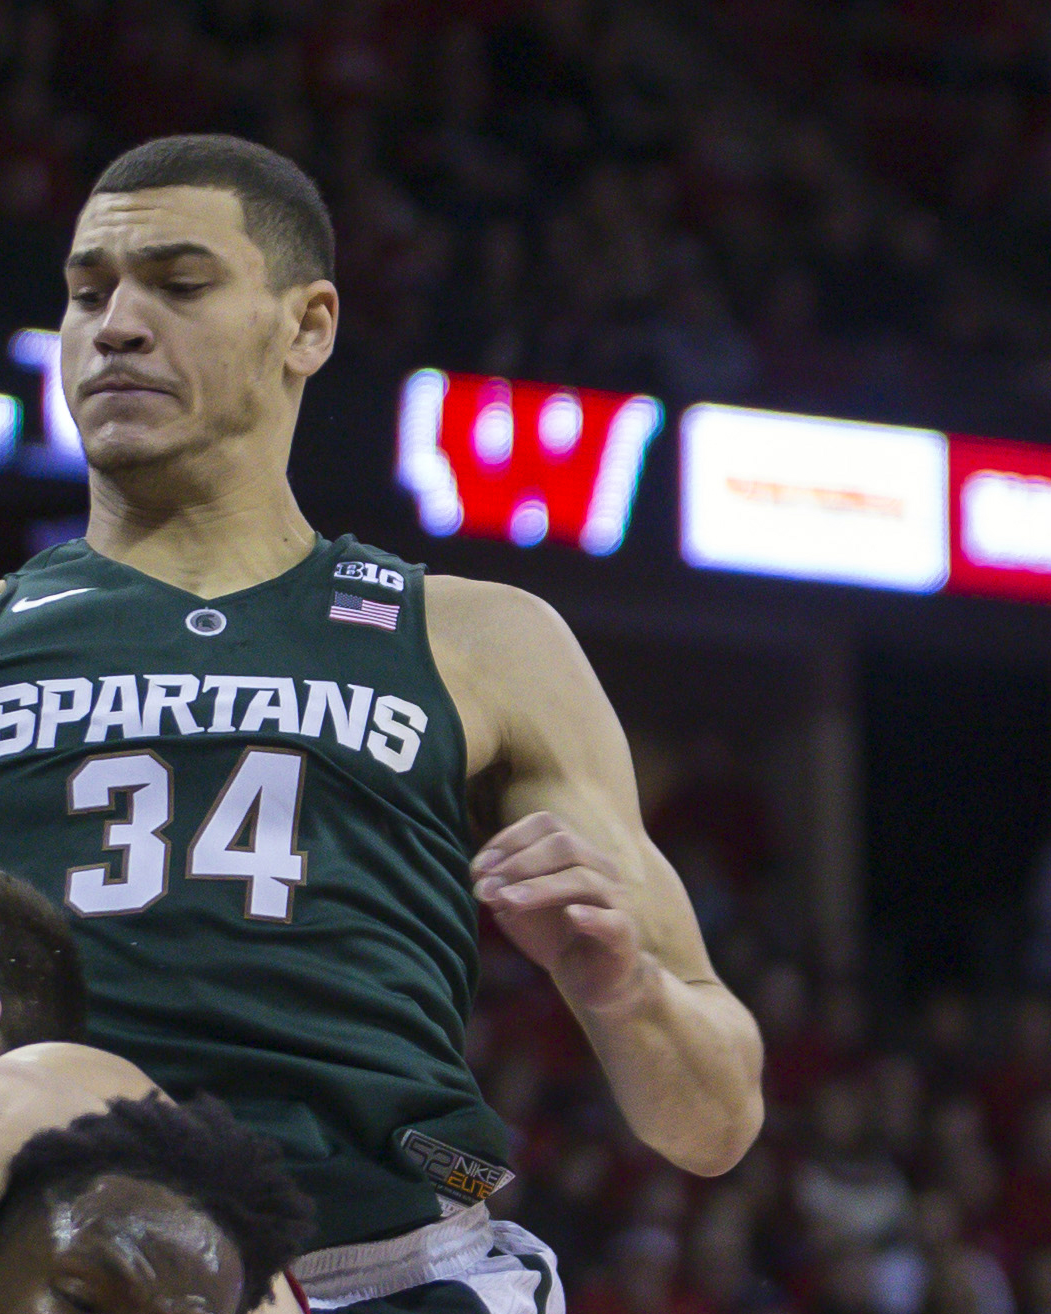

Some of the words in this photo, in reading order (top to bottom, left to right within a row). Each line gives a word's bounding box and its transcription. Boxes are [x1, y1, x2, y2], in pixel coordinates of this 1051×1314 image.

[64, 745, 308, 924] 34
[447, 1170, 493, 1199] ELITE
[454, 1156, 501, 1187] NIKE
